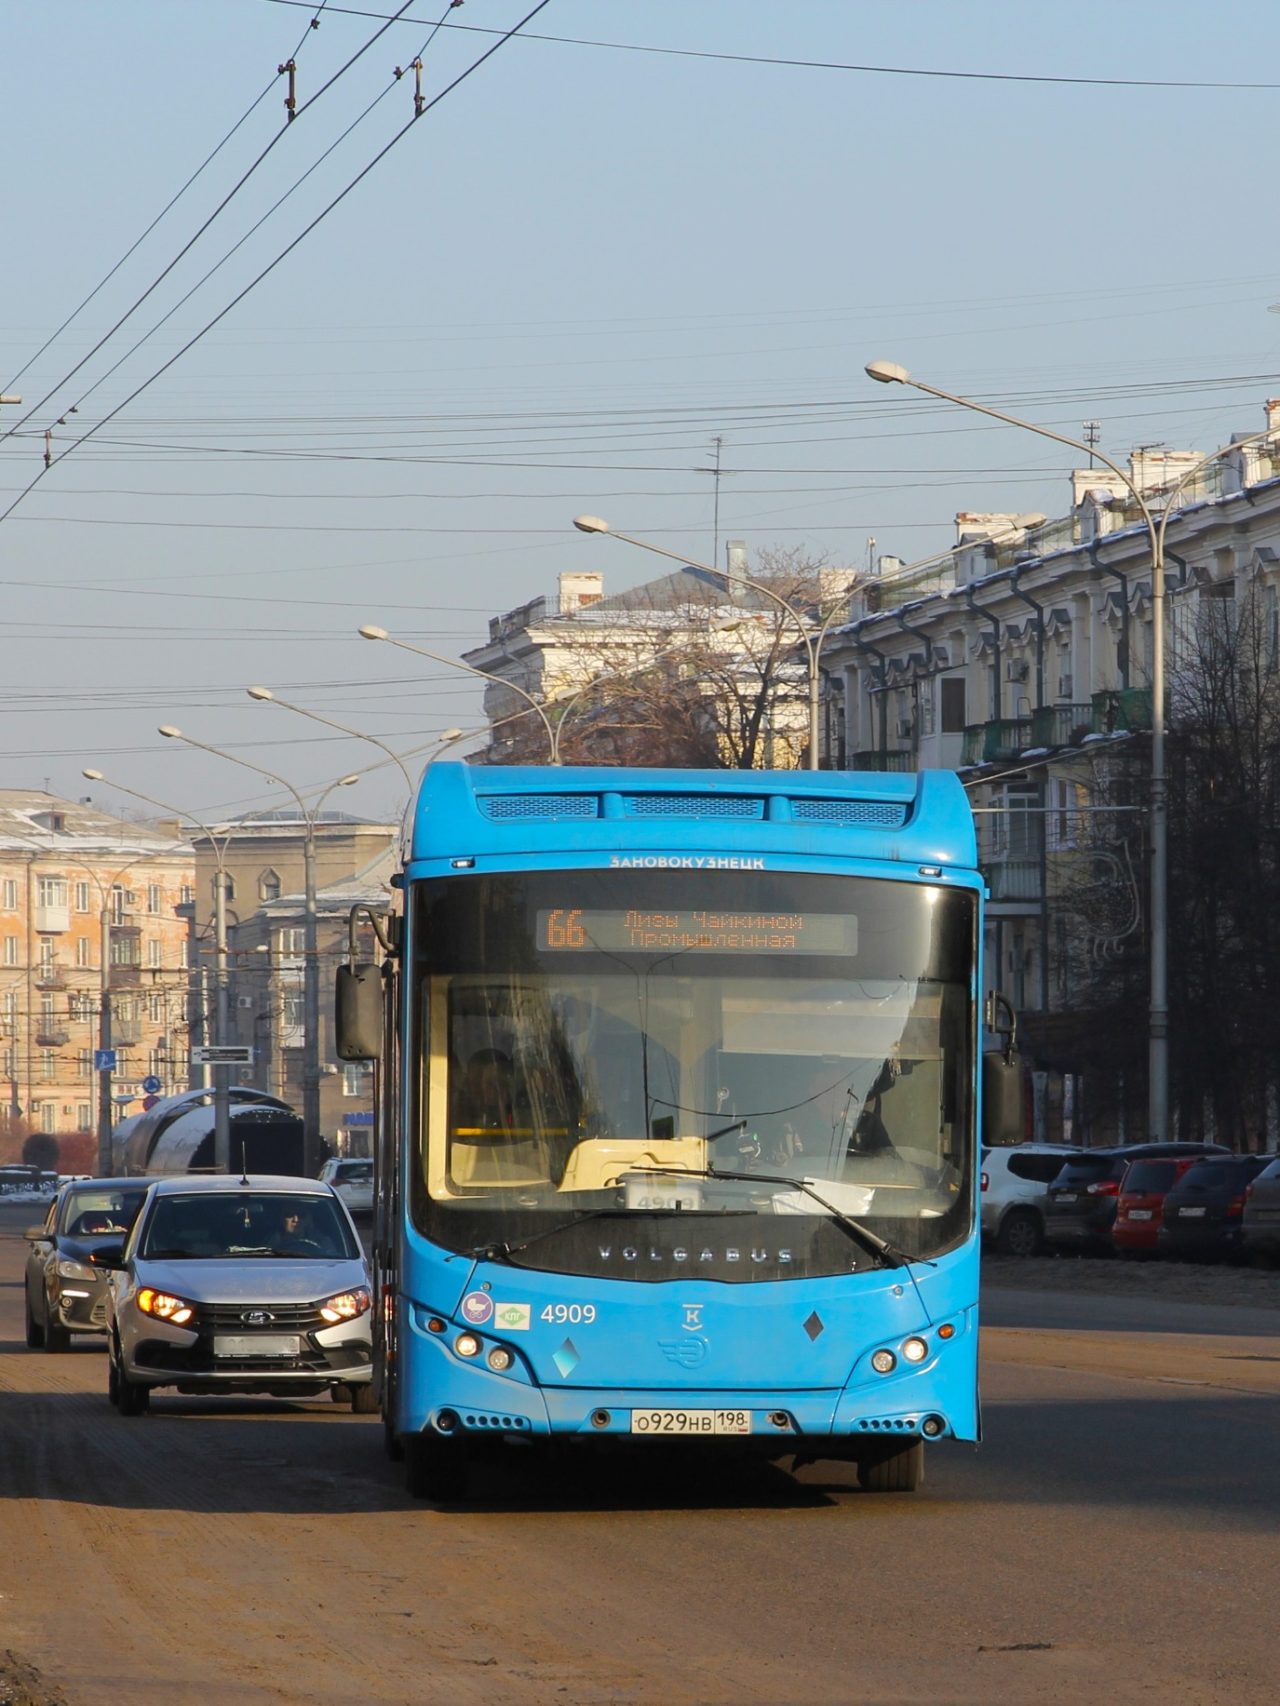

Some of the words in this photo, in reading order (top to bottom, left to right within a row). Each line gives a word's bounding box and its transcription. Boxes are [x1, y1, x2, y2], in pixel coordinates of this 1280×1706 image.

[609, 856, 765, 870] ЗАНОВОКУЗНЕЦК
[546, 909, 585, 948] 66
[623, 910, 678, 928] Лизы
[692, 911, 804, 930] Чайкиной
[630, 929, 797, 948] Промышленная
[599, 1247, 792, 1263] VOLGABUS
[540, 1304, 596, 1324] 4909
[717, 1411, 746, 1426] 198
